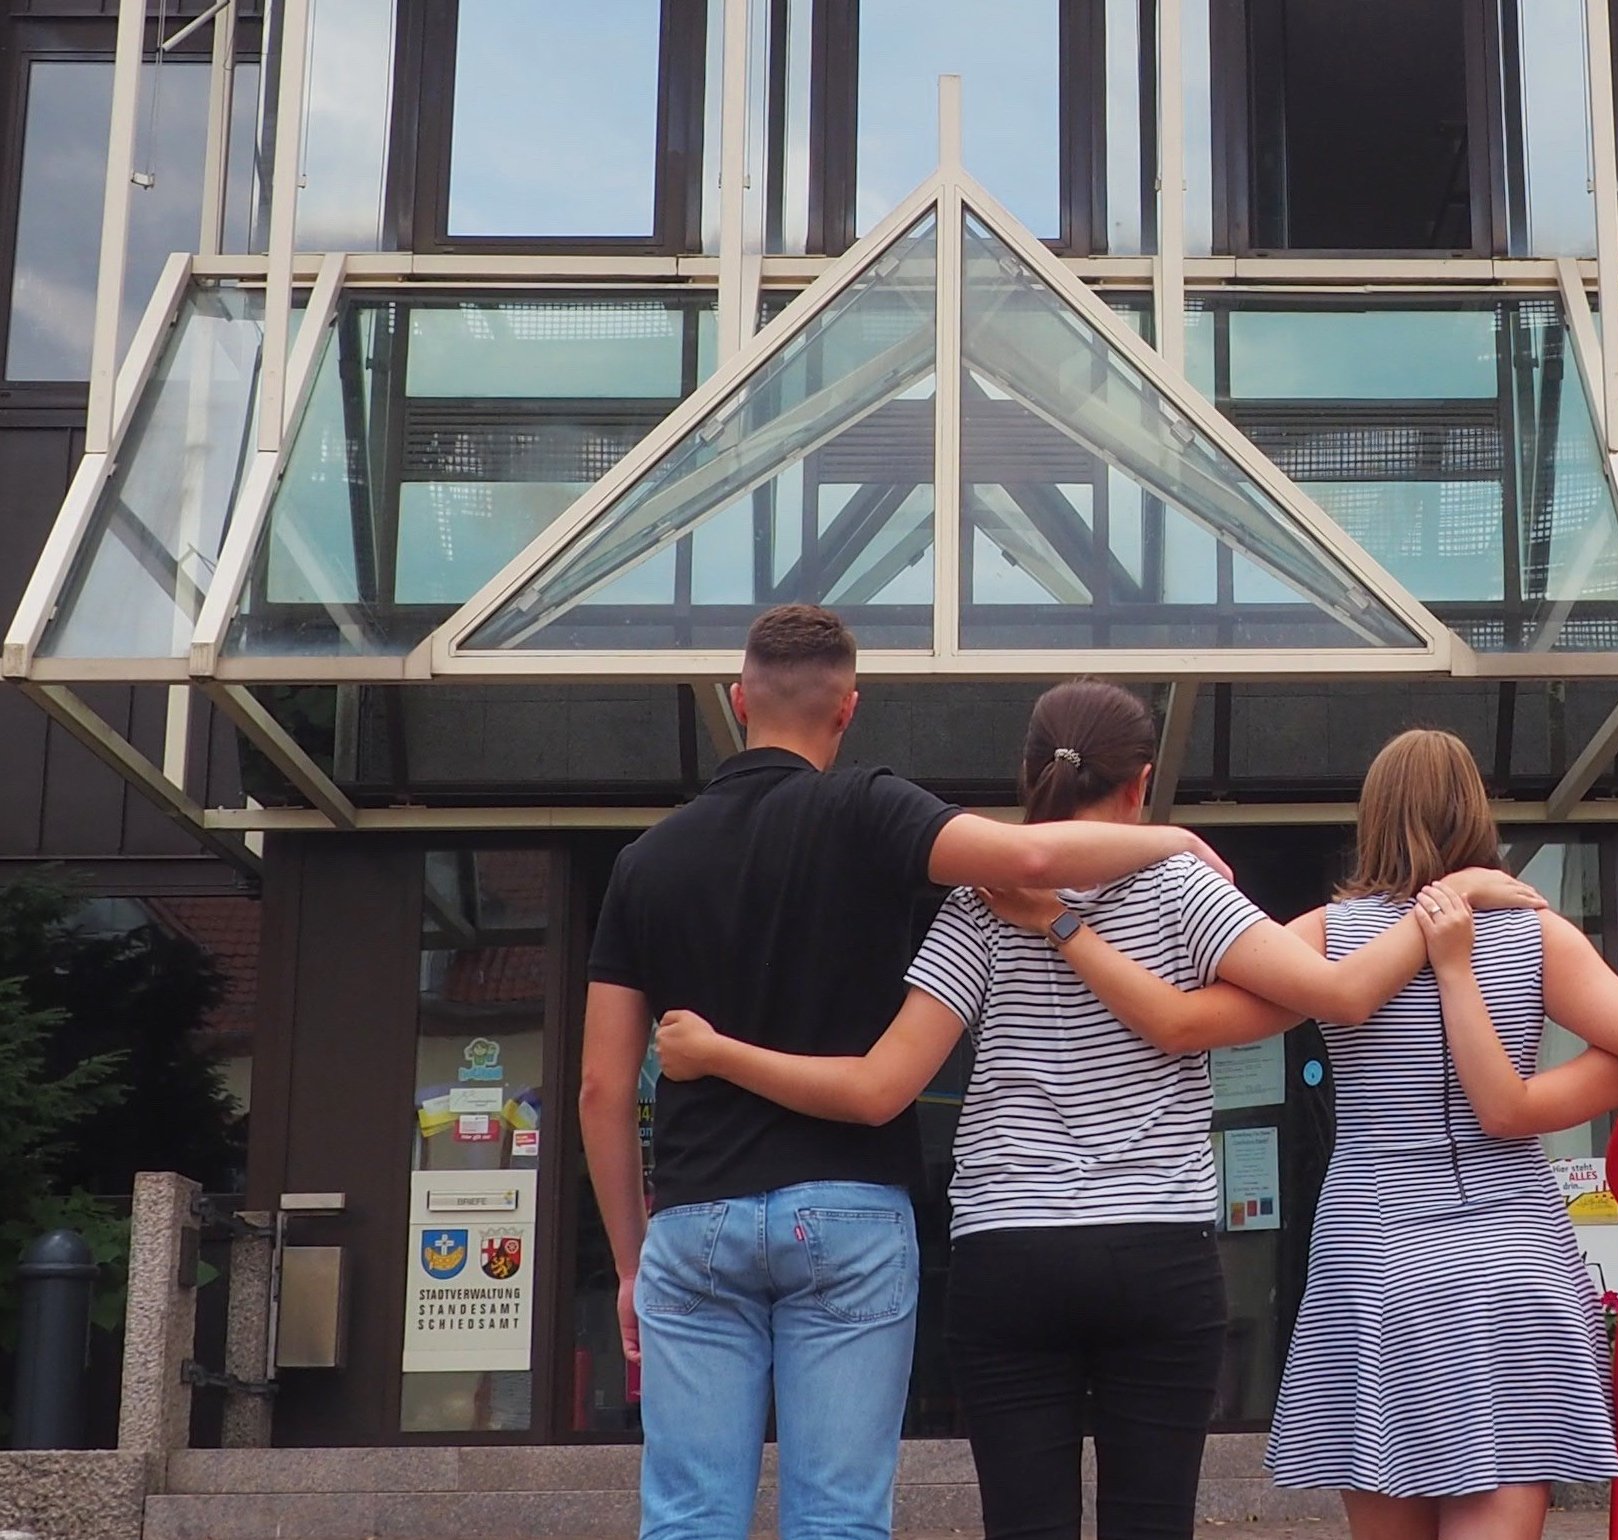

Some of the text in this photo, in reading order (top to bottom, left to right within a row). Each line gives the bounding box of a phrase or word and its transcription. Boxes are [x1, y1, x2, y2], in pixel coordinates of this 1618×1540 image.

[1571, 1162, 1593, 1172] steht
[1569, 1171, 1598, 1180] ALLES
[456, 1197, 488, 1206] BRIEFE
[419, 1287, 521, 1300] STADTVERWALTUNG
[419, 1303, 520, 1315] STANDESAMT
[418, 1318, 519, 1330] SCHIEDSAMT
